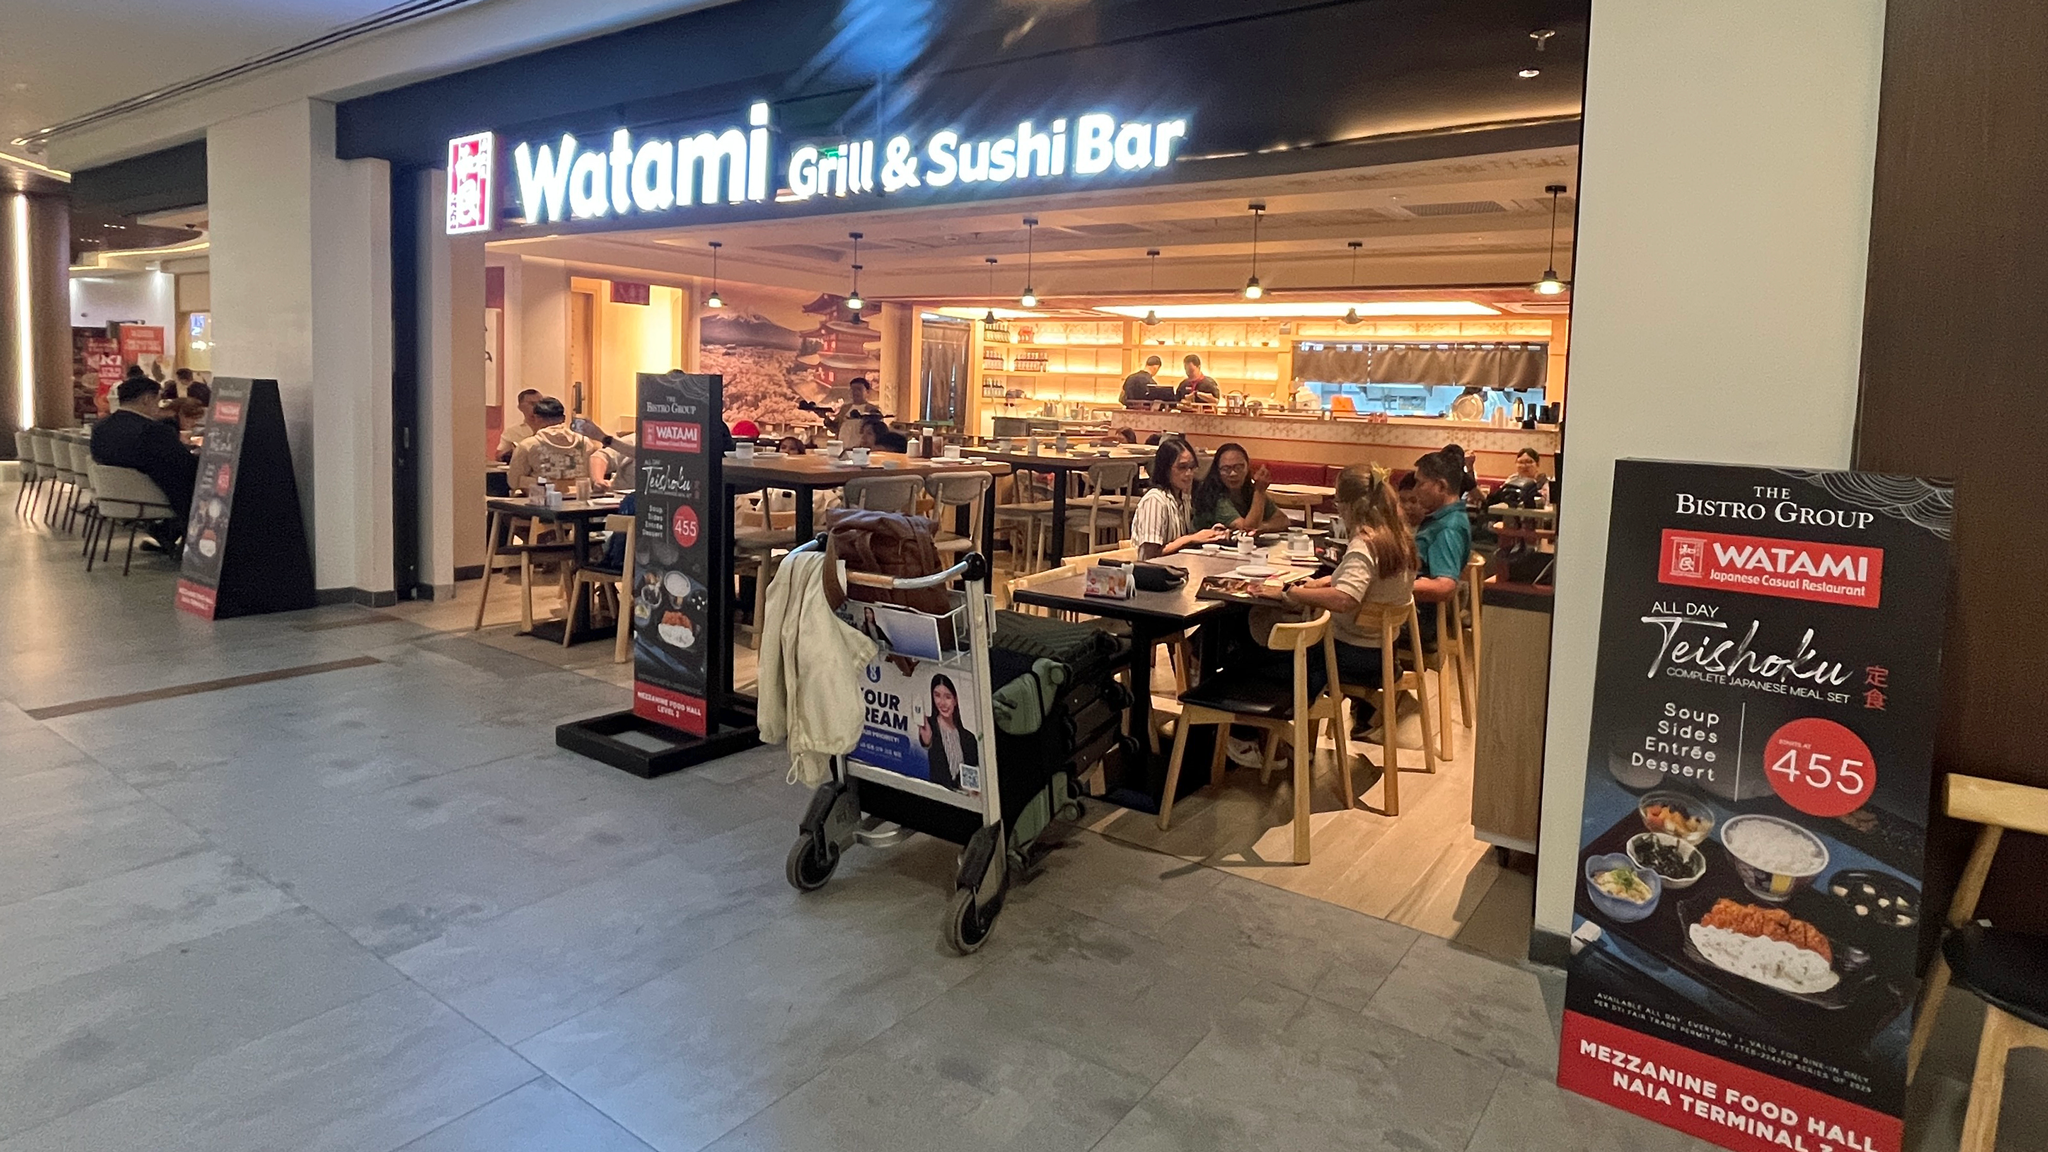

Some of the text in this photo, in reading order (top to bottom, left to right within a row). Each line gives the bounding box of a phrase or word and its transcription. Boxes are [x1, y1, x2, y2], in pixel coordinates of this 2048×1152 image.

[514, 101, 768, 225] Watami
[788, 112, 1187, 197] Grill & Sushi Bar
[671, 402, 697, 415] GROUP
[655, 425, 698, 441] WATAMI
[1753, 485, 1791, 500] THE
[1675, 493, 1874, 530] BISTRO GROUP
[674, 519, 697, 537] 455
[1712, 542, 1869, 583] WATAMI
[1709, 569, 1866, 597] Japanese Casual Restaurant
[1651, 601, 1720, 618] ALL DAY
[1640, 616, 1854, 685] Teishoku
[861, 687, 900, 711] OUR
[1666, 667, 1851, 704] COMPLETE JAPANESE MEAL SET
[1862, 665, 1889, 711] 定食
[657, 704, 675, 717] LEVEL
[669, 700, 686, 711] FOOD
[685, 705, 702, 717] HALL
[865, 706, 908, 731] REAM
[1663, 702, 1720, 729] Soup
[1657, 720, 1718, 744] Sides
[1645, 736, 1716, 762] Entrée
[1631, 751, 1715, 782] Dessert
[1771, 748, 1864, 795] 455
[1593, 998, 1609, 1008] PER
[1611, 1004, 1625, 1014] DTI
[1627, 1008, 1646, 1020] FAIR
[1649, 1016, 1677, 1031] TRADE
[1680, 1026, 1711, 1041] PERMIT
[1795, 1063, 1829, 1079] SERIES
[1832, 1075, 1846, 1084] OF
[1597, 992, 1642, 1010] AVAILABLE
[1645, 1007, 1661, 1017] ALL
[1687, 1020, 1733, 1040] EVERYDAY
[1748, 1039, 1777, 1054] VALID
[1780, 1049, 1799, 1060] FOR
[1843, 1070, 1871, 1084] ONLY
[1579, 1038, 1878, 1152] MEZZANINE FOOD HALL
[1612, 1070, 1672, 1106] NAIA
[1679, 1093, 1809, 1152] TERMINAL
